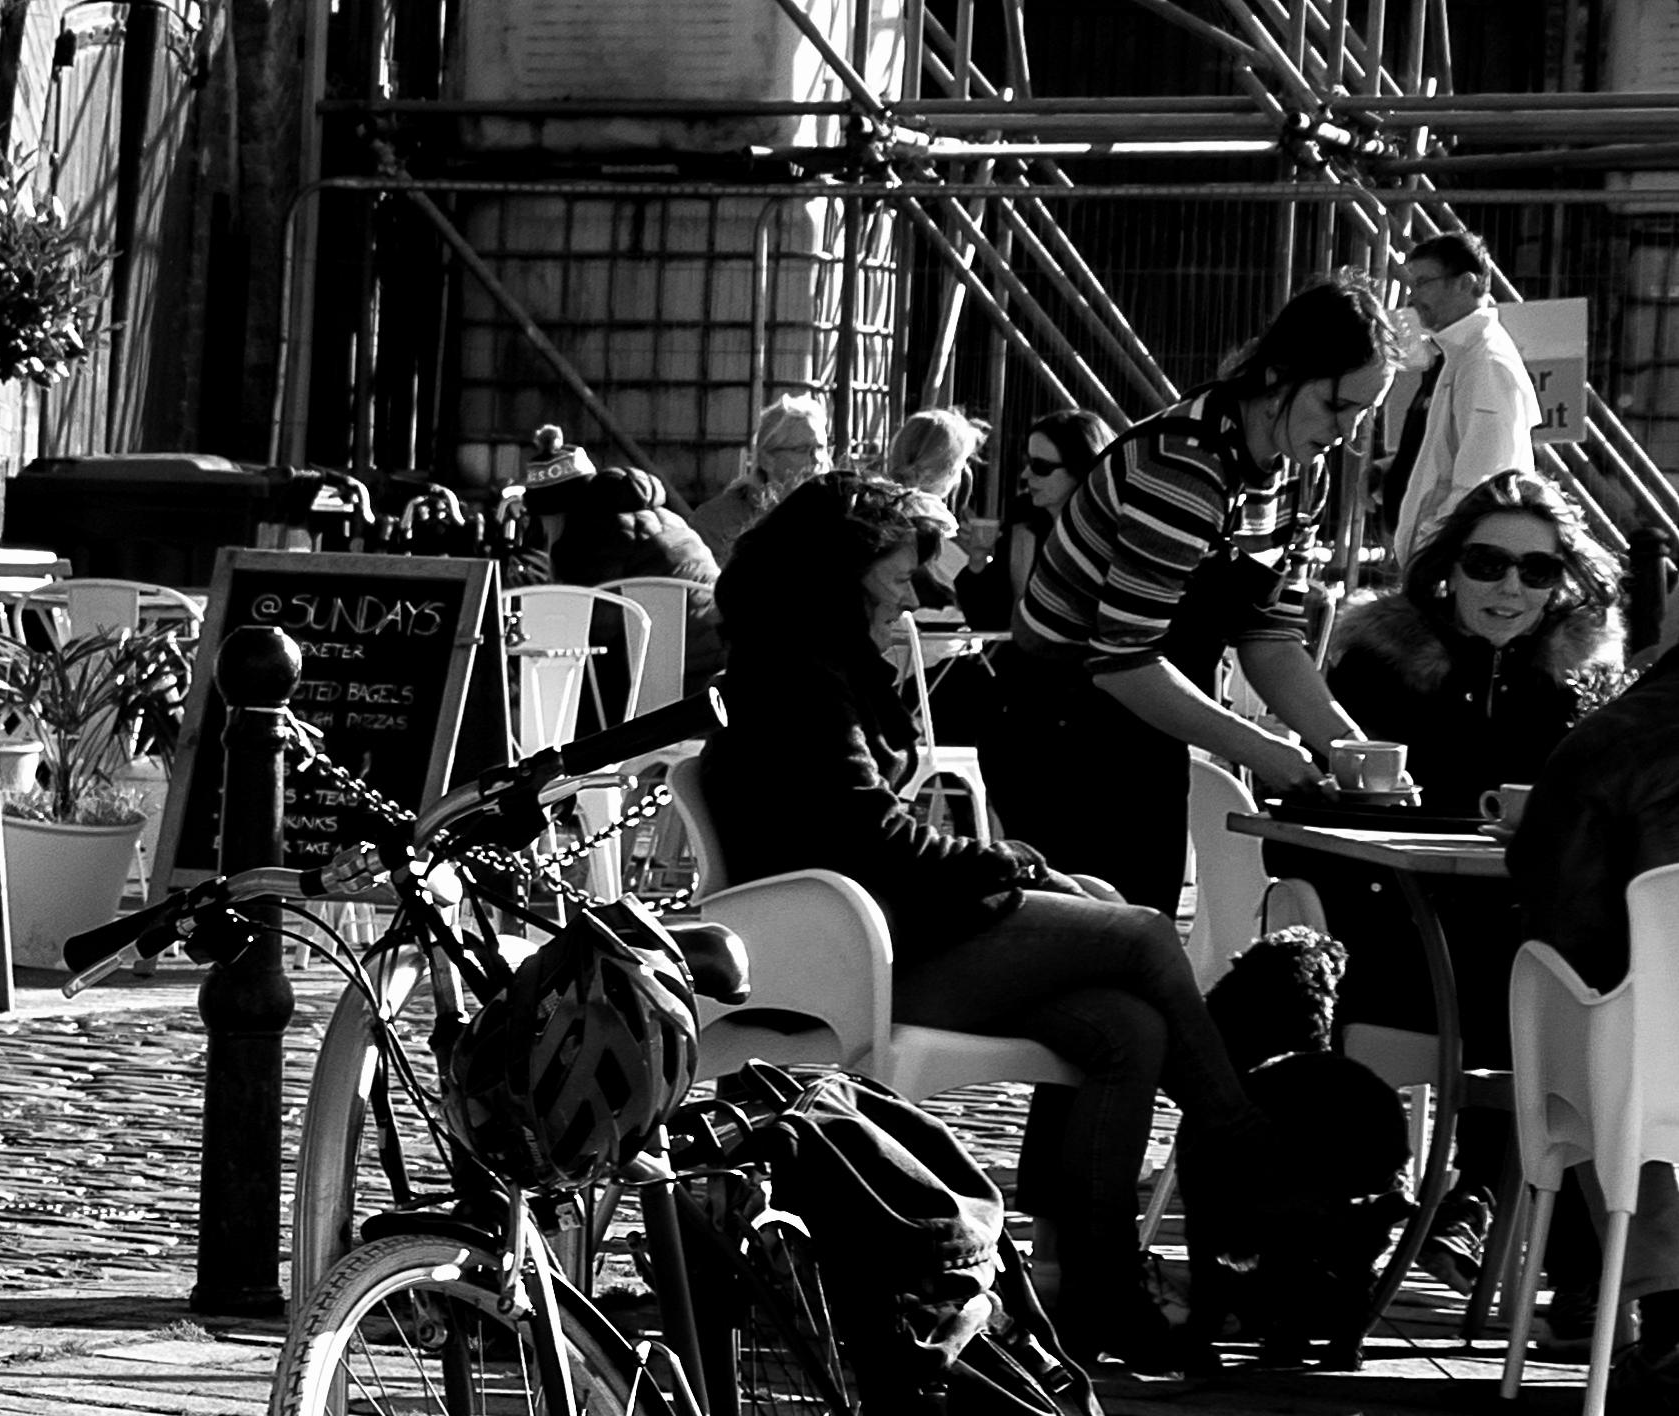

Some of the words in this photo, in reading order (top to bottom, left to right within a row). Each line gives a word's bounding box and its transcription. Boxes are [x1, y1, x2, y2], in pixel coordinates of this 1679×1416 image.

[299, 641, 365, 658] EXETER
[346, 681, 414, 704] BAGELS
[346, 712, 408, 730] PIZZAS
